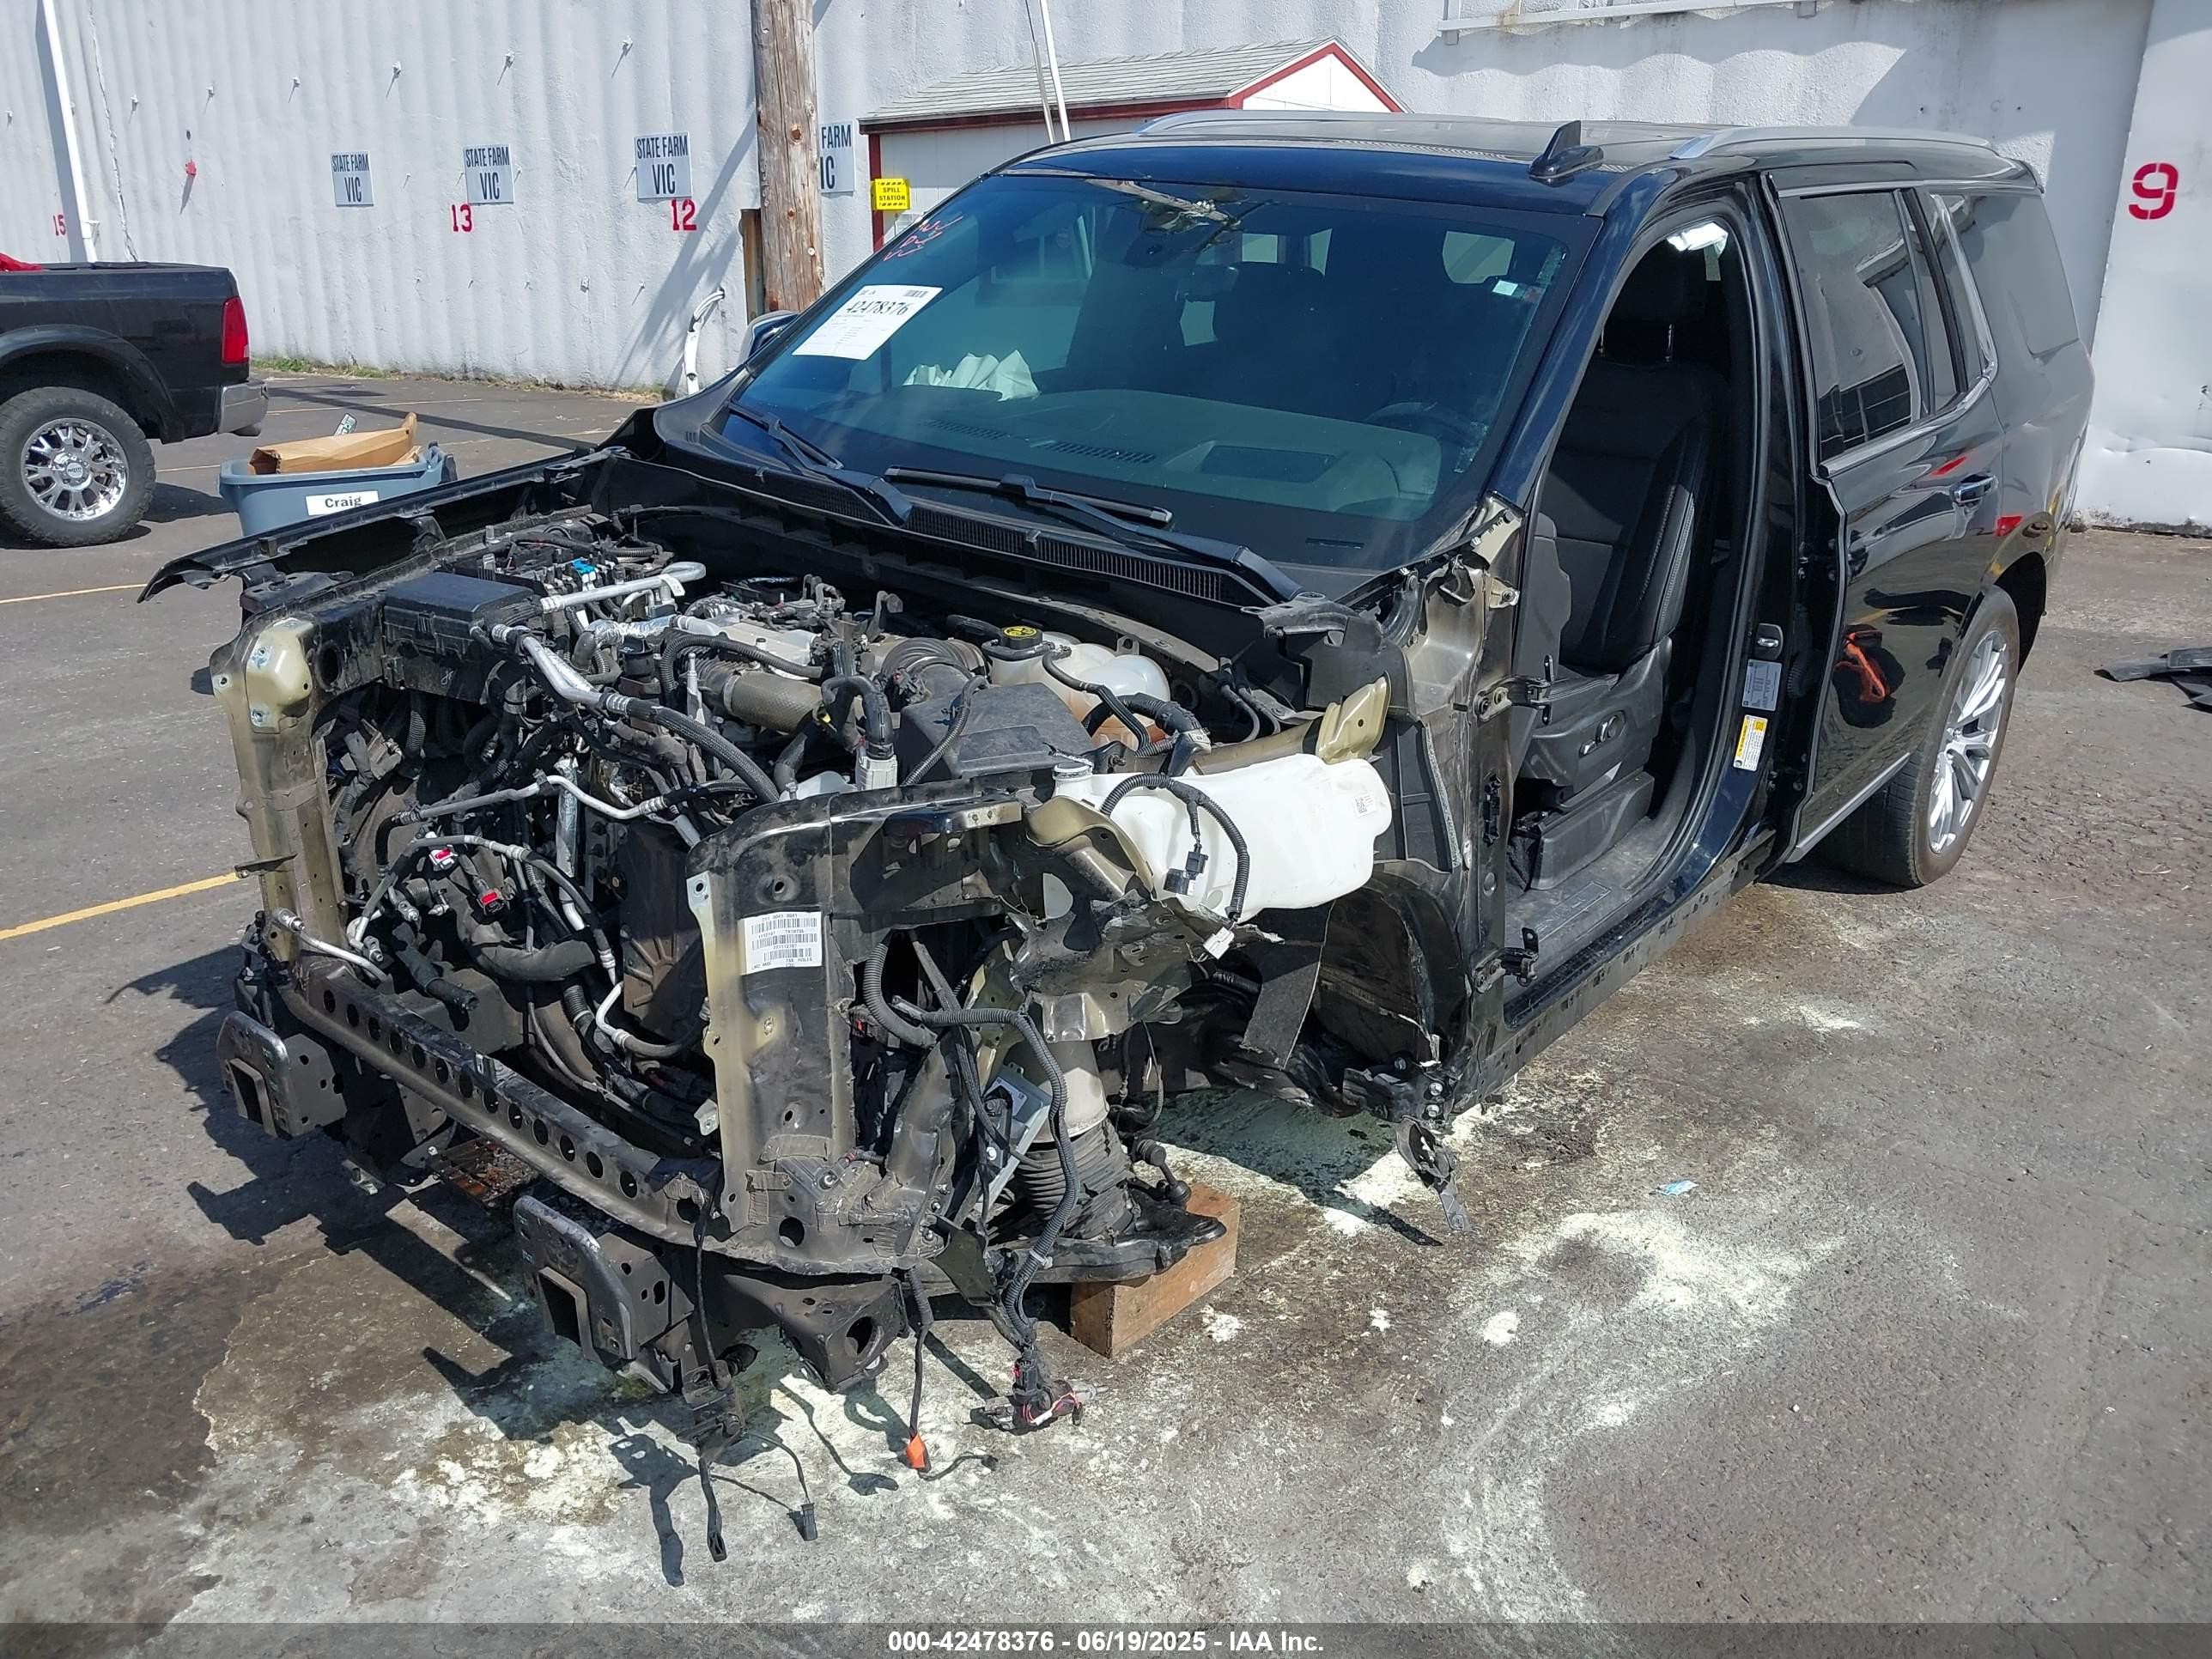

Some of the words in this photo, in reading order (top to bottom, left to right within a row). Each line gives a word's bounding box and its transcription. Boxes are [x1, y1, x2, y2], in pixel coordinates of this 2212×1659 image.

[636, 137, 661, 160] STATE
[662, 135, 688, 157] FARM
[821, 125, 852, 149] FARM
[332, 155, 350, 173] STATE
[350, 153, 370, 172] FARM
[465, 148, 487, 167] STATE
[488, 146, 510, 167] FARM
[652, 163, 676, 195] VIC
[820, 155, 836, 190] IC
[344, 176, 362, 203] VIC
[479, 172, 500, 200] VIC
[2129, 162, 2179, 220] 9
[52, 215, 66, 236] 15
[452, 204, 472, 232] 13
[672, 198, 697, 231] 12
[847, 301, 913, 316] 42478376
[325, 495, 362, 508] Craig
